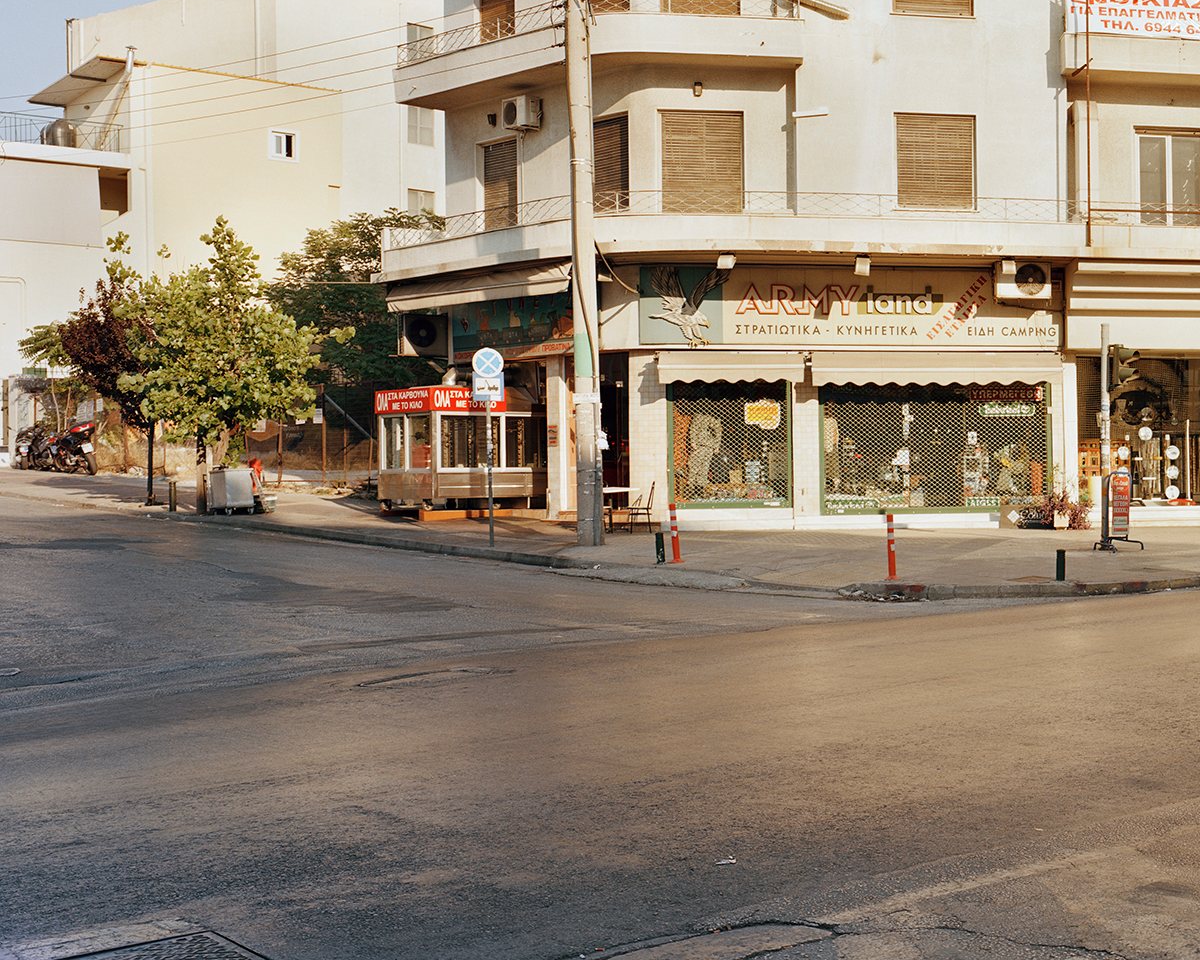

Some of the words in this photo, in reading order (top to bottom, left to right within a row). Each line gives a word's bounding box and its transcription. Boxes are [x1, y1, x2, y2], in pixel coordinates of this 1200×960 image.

[1070, 6, 1093, 15] ΓΙΑ
[1144, 22, 1181, 33] 6944
[735, 282, 860, 316] ARMY
[866, 285, 933, 315] land
[735, 325, 821, 335] ΣΤΡΑΤΙΩΤΙΚΑ
[837, 326, 918, 336] ΚΥΝΗΓΕΤΙΚΑ
[967, 326, 995, 336] ΕΙΔΗ
[1001, 327, 1057, 337] CAMPING
[377, 393, 388, 411] ΟΛΑ
[387, 392, 398, 400] ΣΤΑ
[399, 390, 429, 399] ΚΑΡΒΟΥΝΑ
[434, 390, 451, 408] ΟΛΑ
[450, 390, 463, 399] ΣΤΑ
[455, 400, 467, 408] ΜΕ
[468, 400, 478, 408] ΤΟ
[392, 402, 400, 410] ΜΕ
